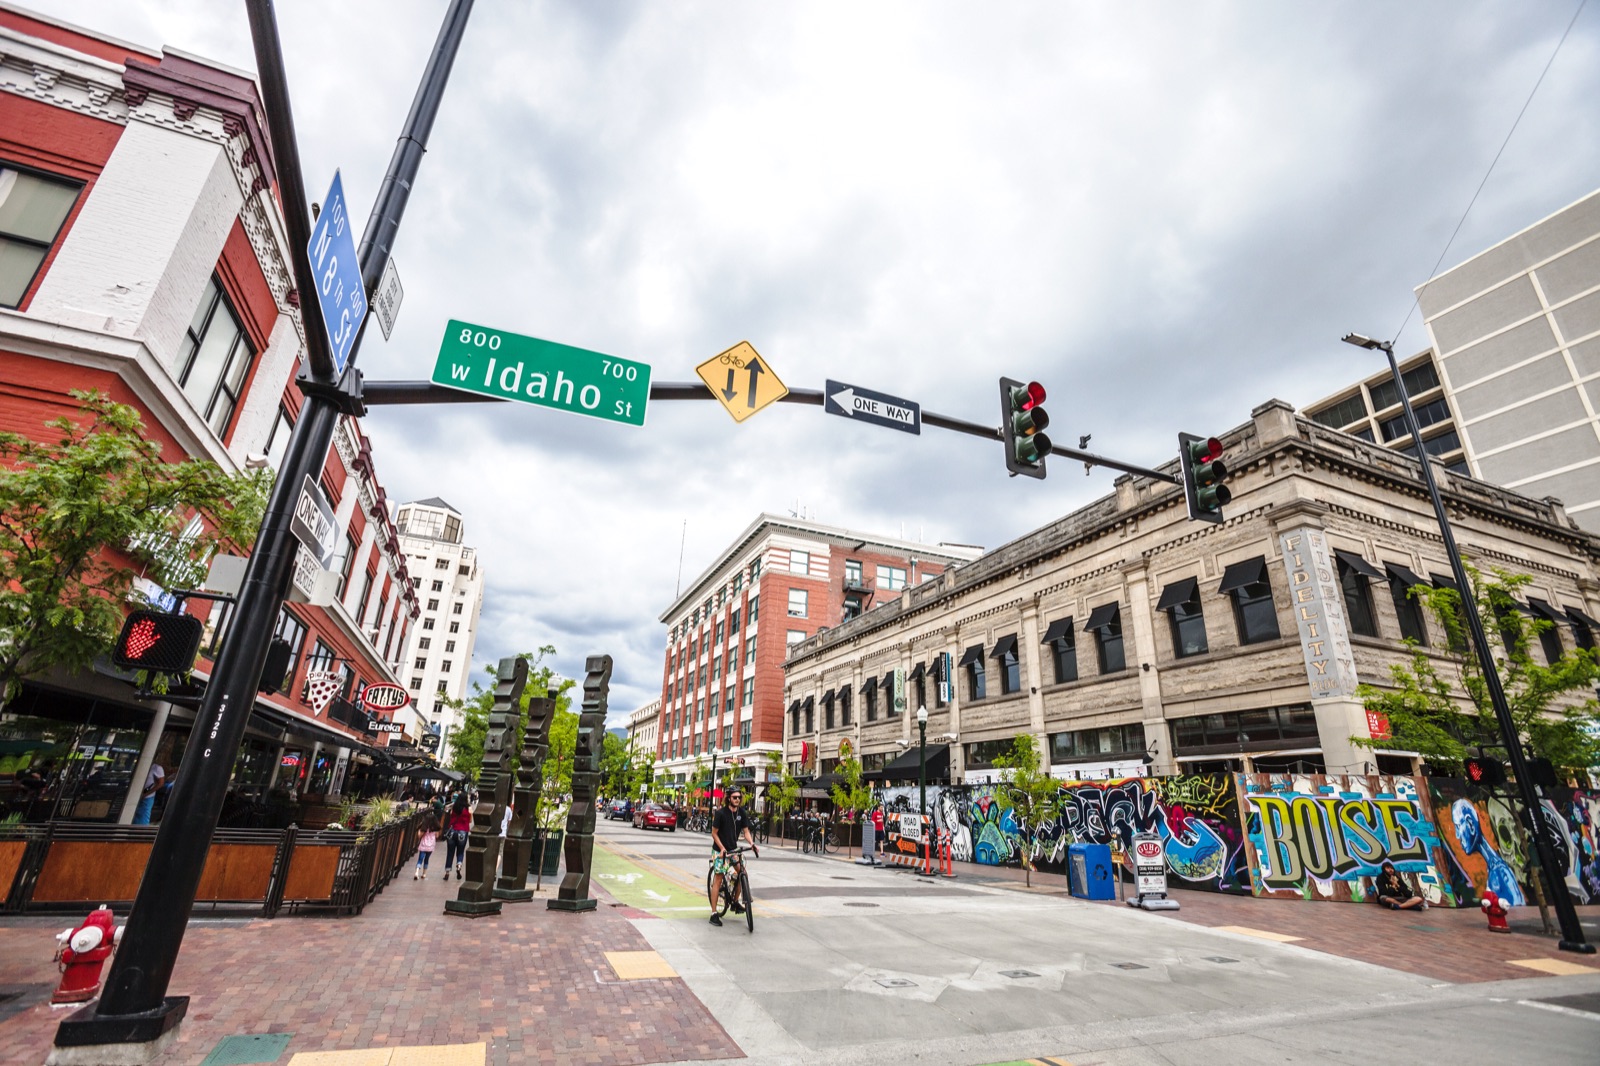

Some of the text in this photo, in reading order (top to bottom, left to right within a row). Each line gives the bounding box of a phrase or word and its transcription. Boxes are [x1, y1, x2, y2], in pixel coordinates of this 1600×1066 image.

[332, 195, 344, 237] 100
[314, 220, 332, 270] N
[334, 308, 352, 357] St
[350, 281, 362, 318] 200
[459, 328, 502, 350] 800
[483, 357, 601, 410] Idaho
[613, 400, 632, 417] St
[601, 360, 637, 382] 700
[853, 398, 911, 422] ONE WAY
[300, 495, 331, 545] ONE WAY
[302, 553, 318, 574] EXCEPT
[295, 567, 314, 595] BICYCLES
[1285, 534, 1329, 675] FIDELITY
[204, 704, 226, 757] 3129 C
[902, 827, 920, 838] CLOSED
[904, 817, 916, 826] ROAD
[1138, 843, 1160, 853] GUHO
[1247, 797, 1428, 888] BOISE
